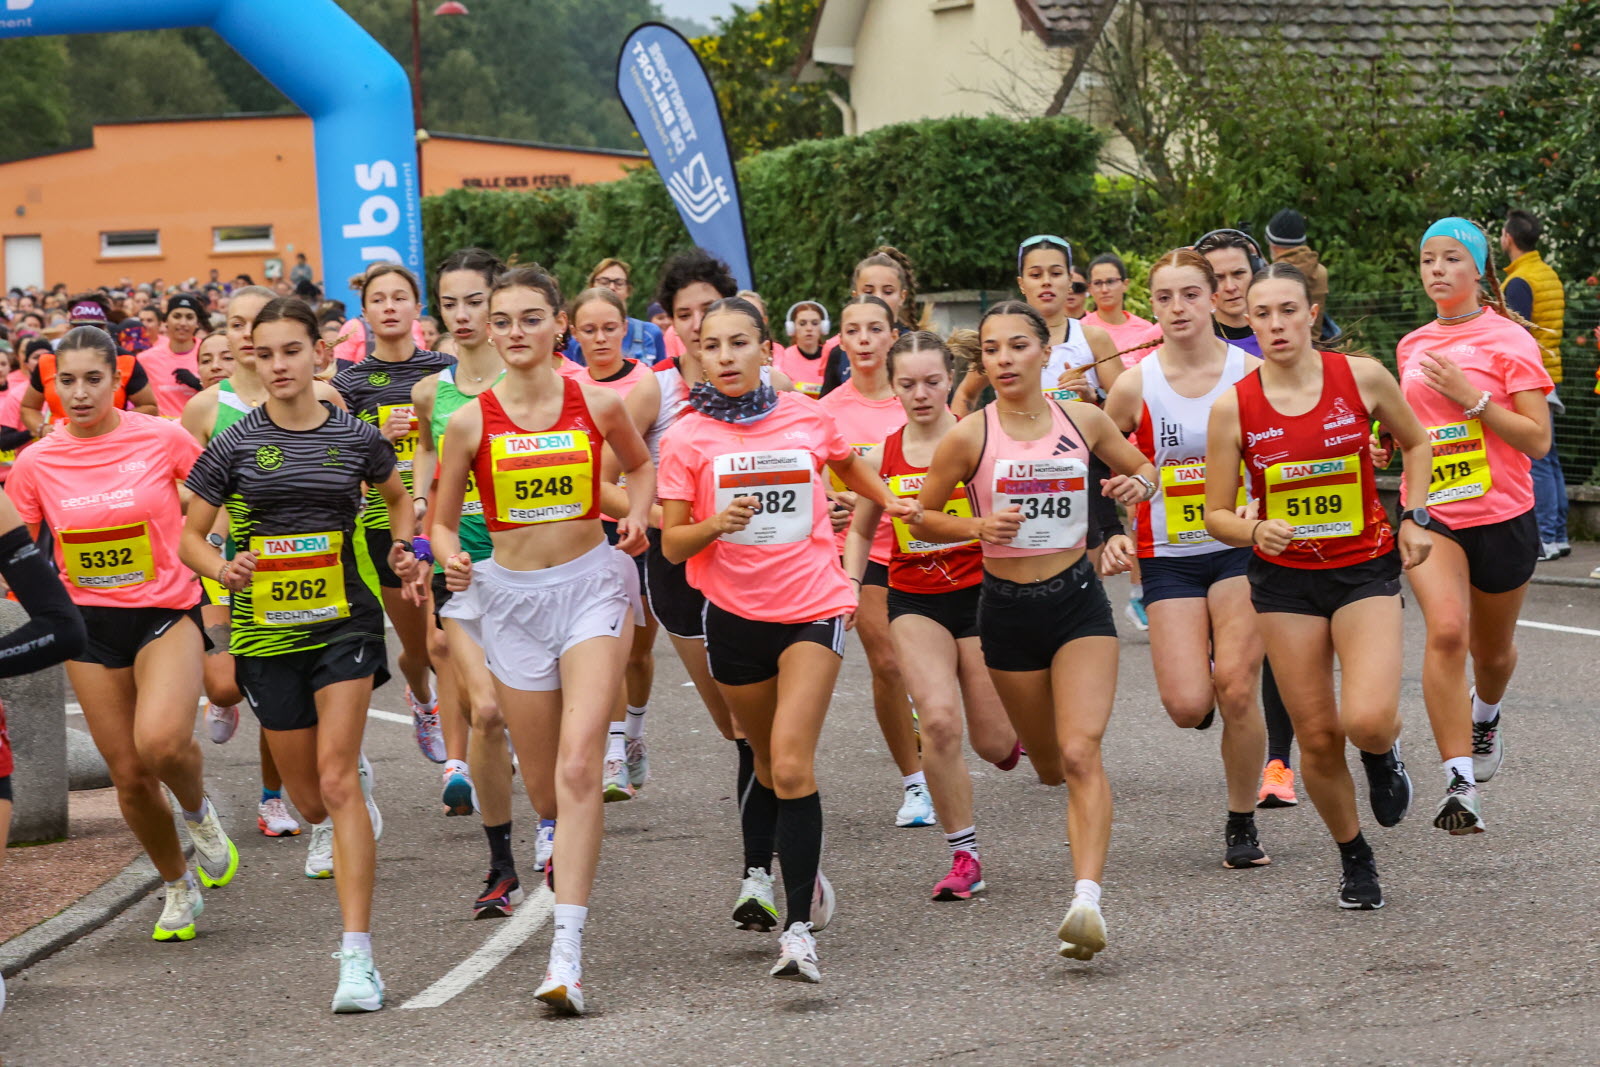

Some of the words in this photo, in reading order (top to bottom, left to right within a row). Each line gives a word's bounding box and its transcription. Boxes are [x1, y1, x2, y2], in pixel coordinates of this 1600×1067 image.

[508, 434, 572, 452] TANDEM
[1282, 461, 1344, 479] TANDEM
[1430, 460, 1472, 485] 178
[515, 475, 574, 500] 5248
[733, 489, 797, 516] 382
[1286, 494, 1343, 517] 5189
[265, 536, 328, 553] TANDEM
[79, 547, 134, 570] 5332
[271, 578, 328, 602] 5262
[1015, 578, 1066, 598] PRO
